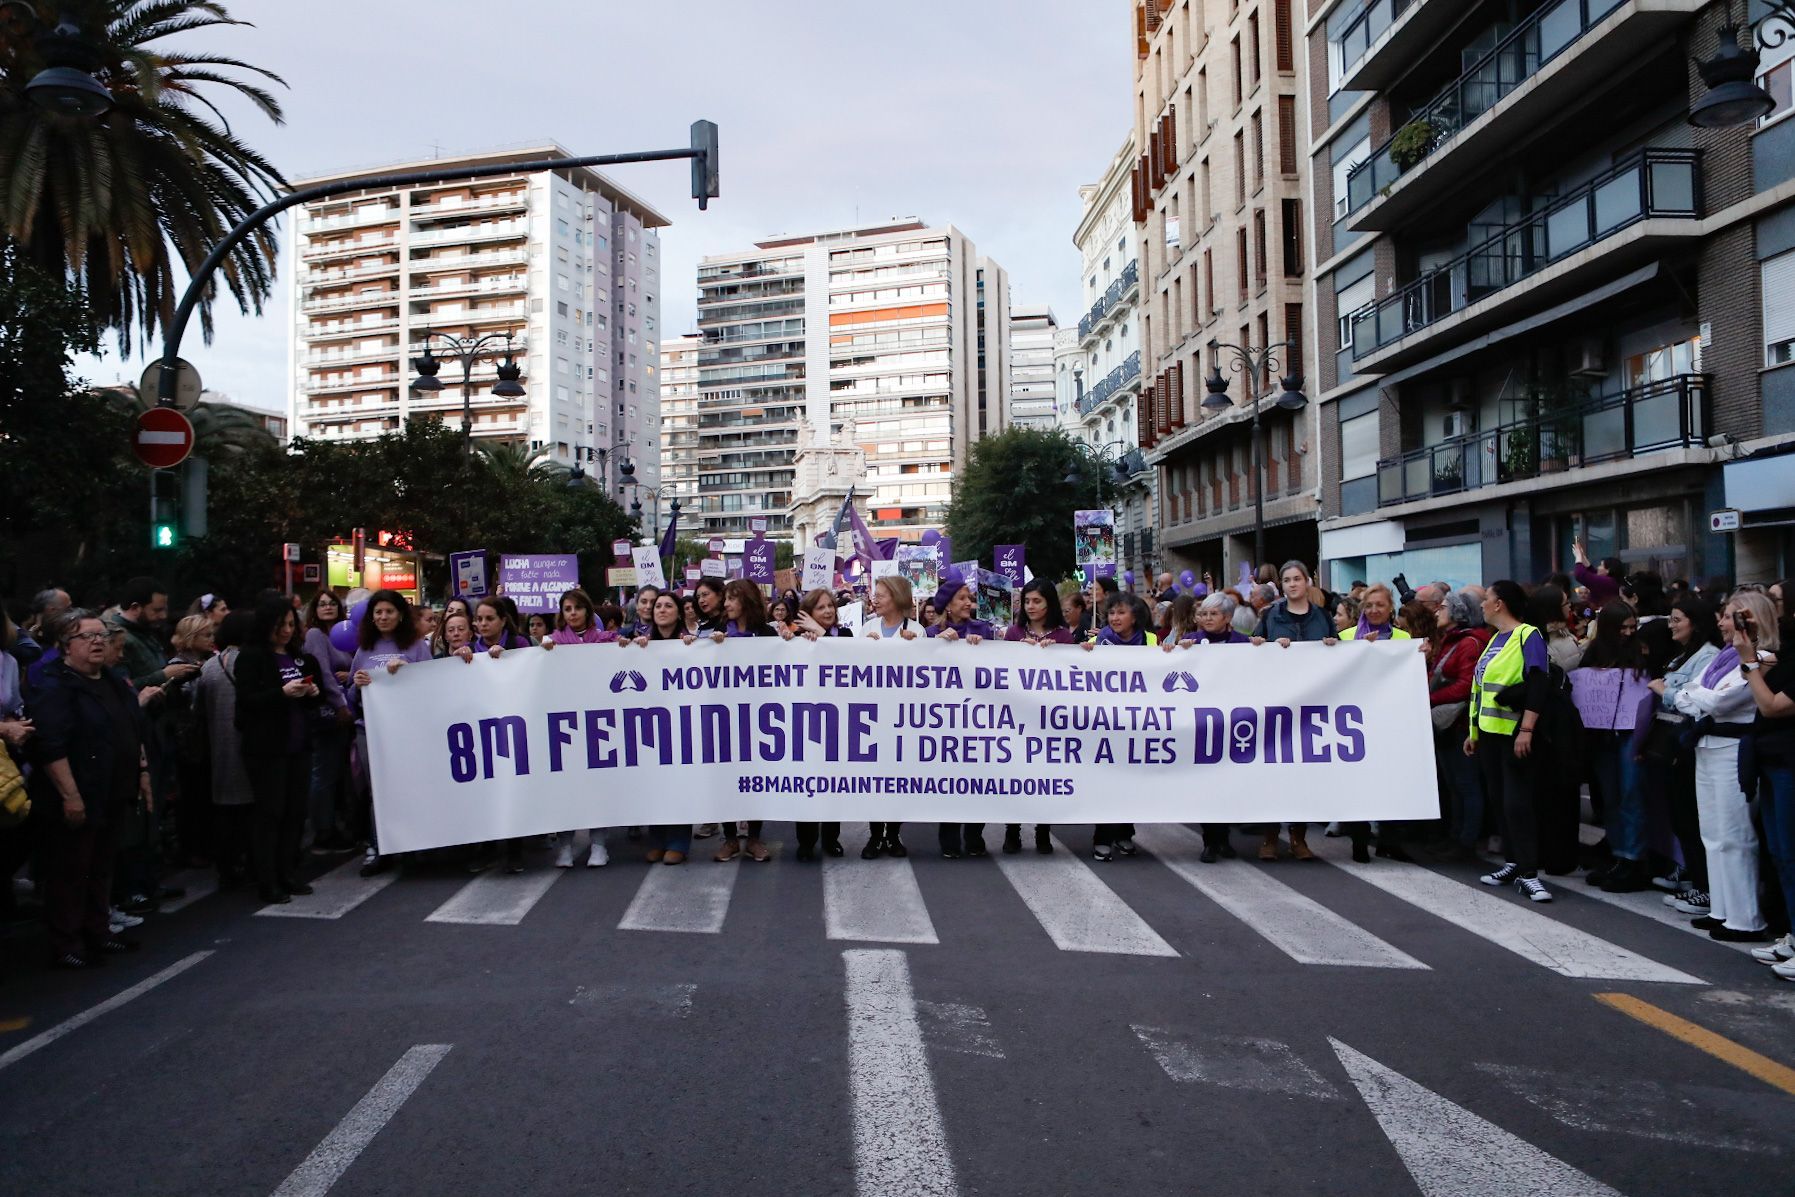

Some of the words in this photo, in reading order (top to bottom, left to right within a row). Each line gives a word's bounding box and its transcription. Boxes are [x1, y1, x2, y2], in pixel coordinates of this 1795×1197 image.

[504, 558, 530, 569] LUCHA
[532, 582, 539, 592] A
[519, 595, 543, 607] FALTA
[662, 664, 808, 690] MOVIMENT
[819, 664, 964, 689] FEMINISTA
[975, 667, 1009, 690] DE
[1018, 665, 1147, 693] VALÈNCIA
[447, 715, 530, 783] 8M
[547, 702, 879, 772] FEMINISME
[894, 697, 1026, 735] JUSTÍCIA,
[1040, 704, 1176, 731] IGUALTAT
[1193, 704, 1366, 765] DONES
[896, 735, 903, 762] I
[919, 735, 1012, 763] DRETS
[1025, 736, 1083, 764] PER
[1094, 737, 1115, 764] A
[1128, 737, 1177, 764] LES
[738, 776, 1075, 798] #8MARÇDIAINTERNACIONALDONES
